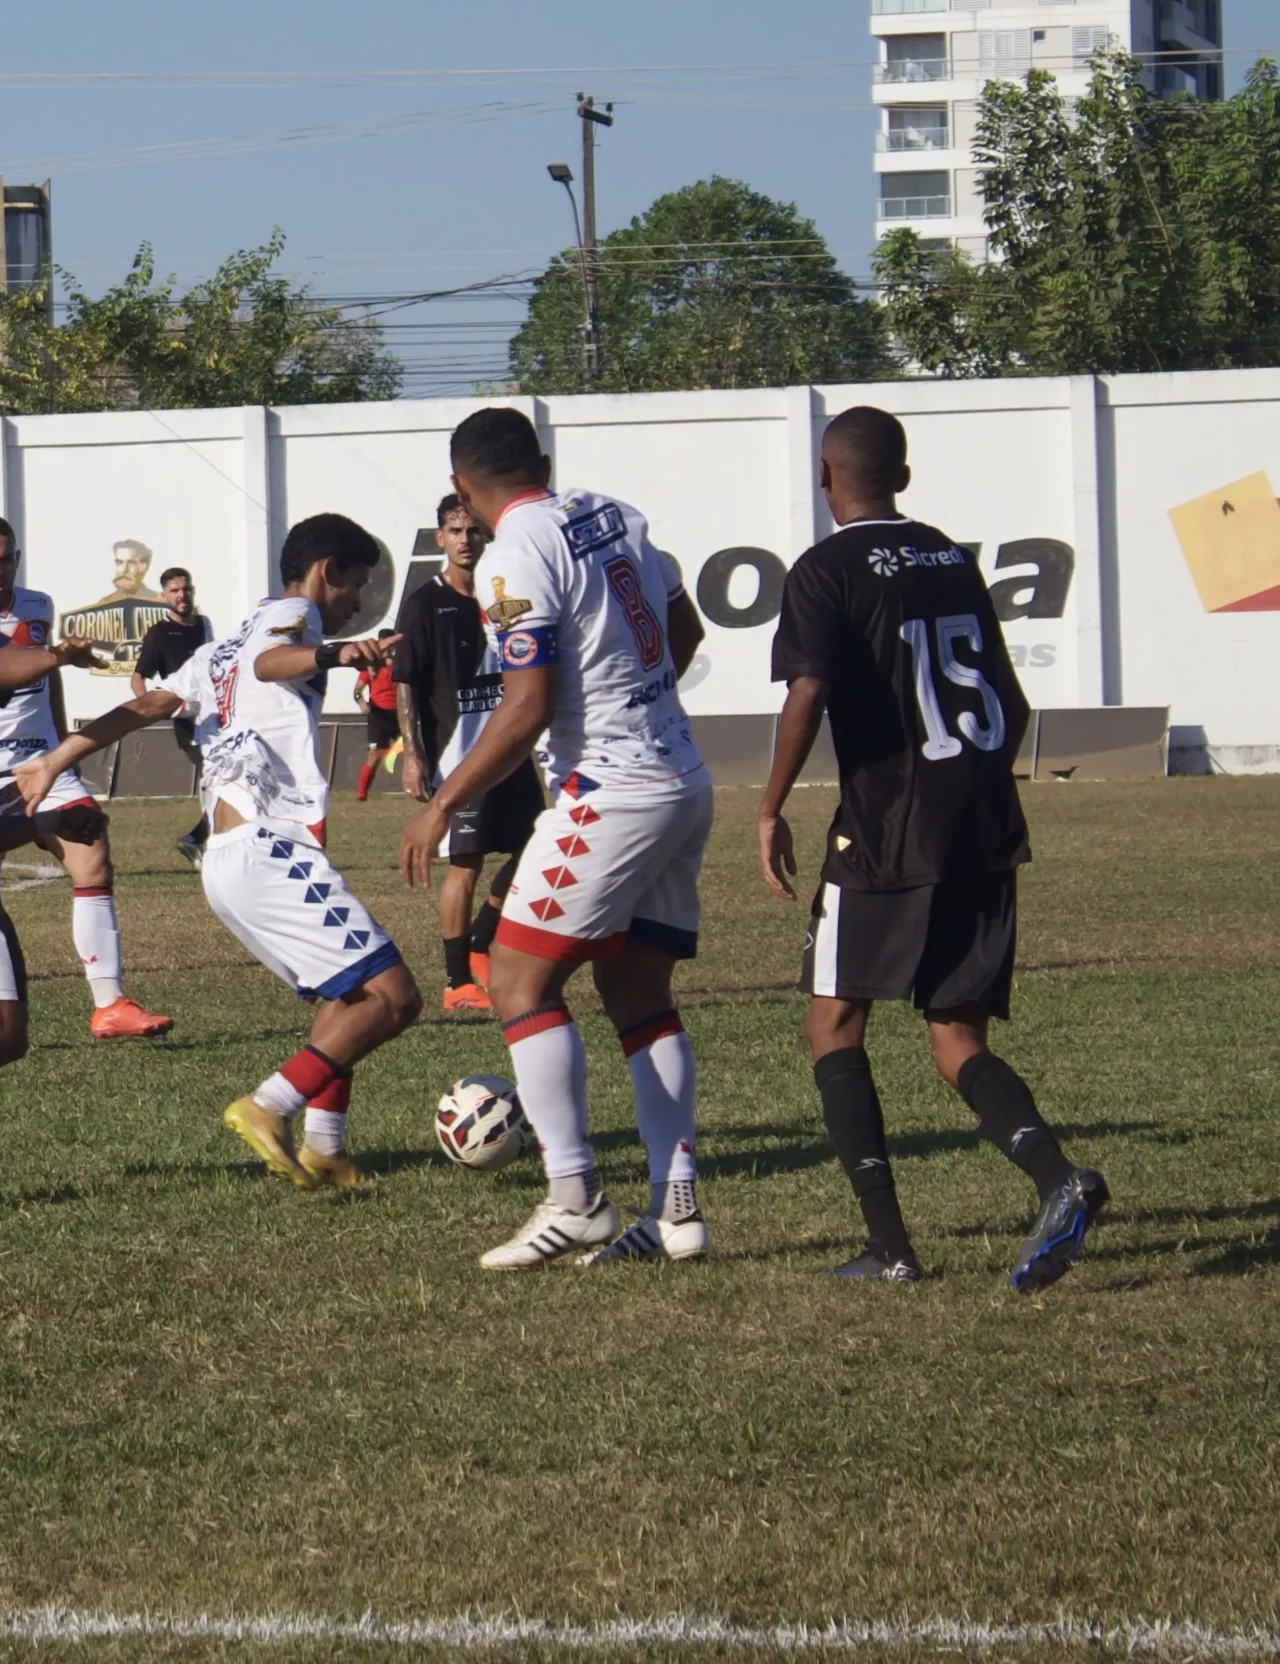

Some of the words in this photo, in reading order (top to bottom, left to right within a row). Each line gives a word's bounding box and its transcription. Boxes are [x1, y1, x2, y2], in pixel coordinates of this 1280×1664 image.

[900, 546, 967, 567] Sicredi
[63, 607, 128, 642] CORONEL
[899, 613, 1006, 761] 15
